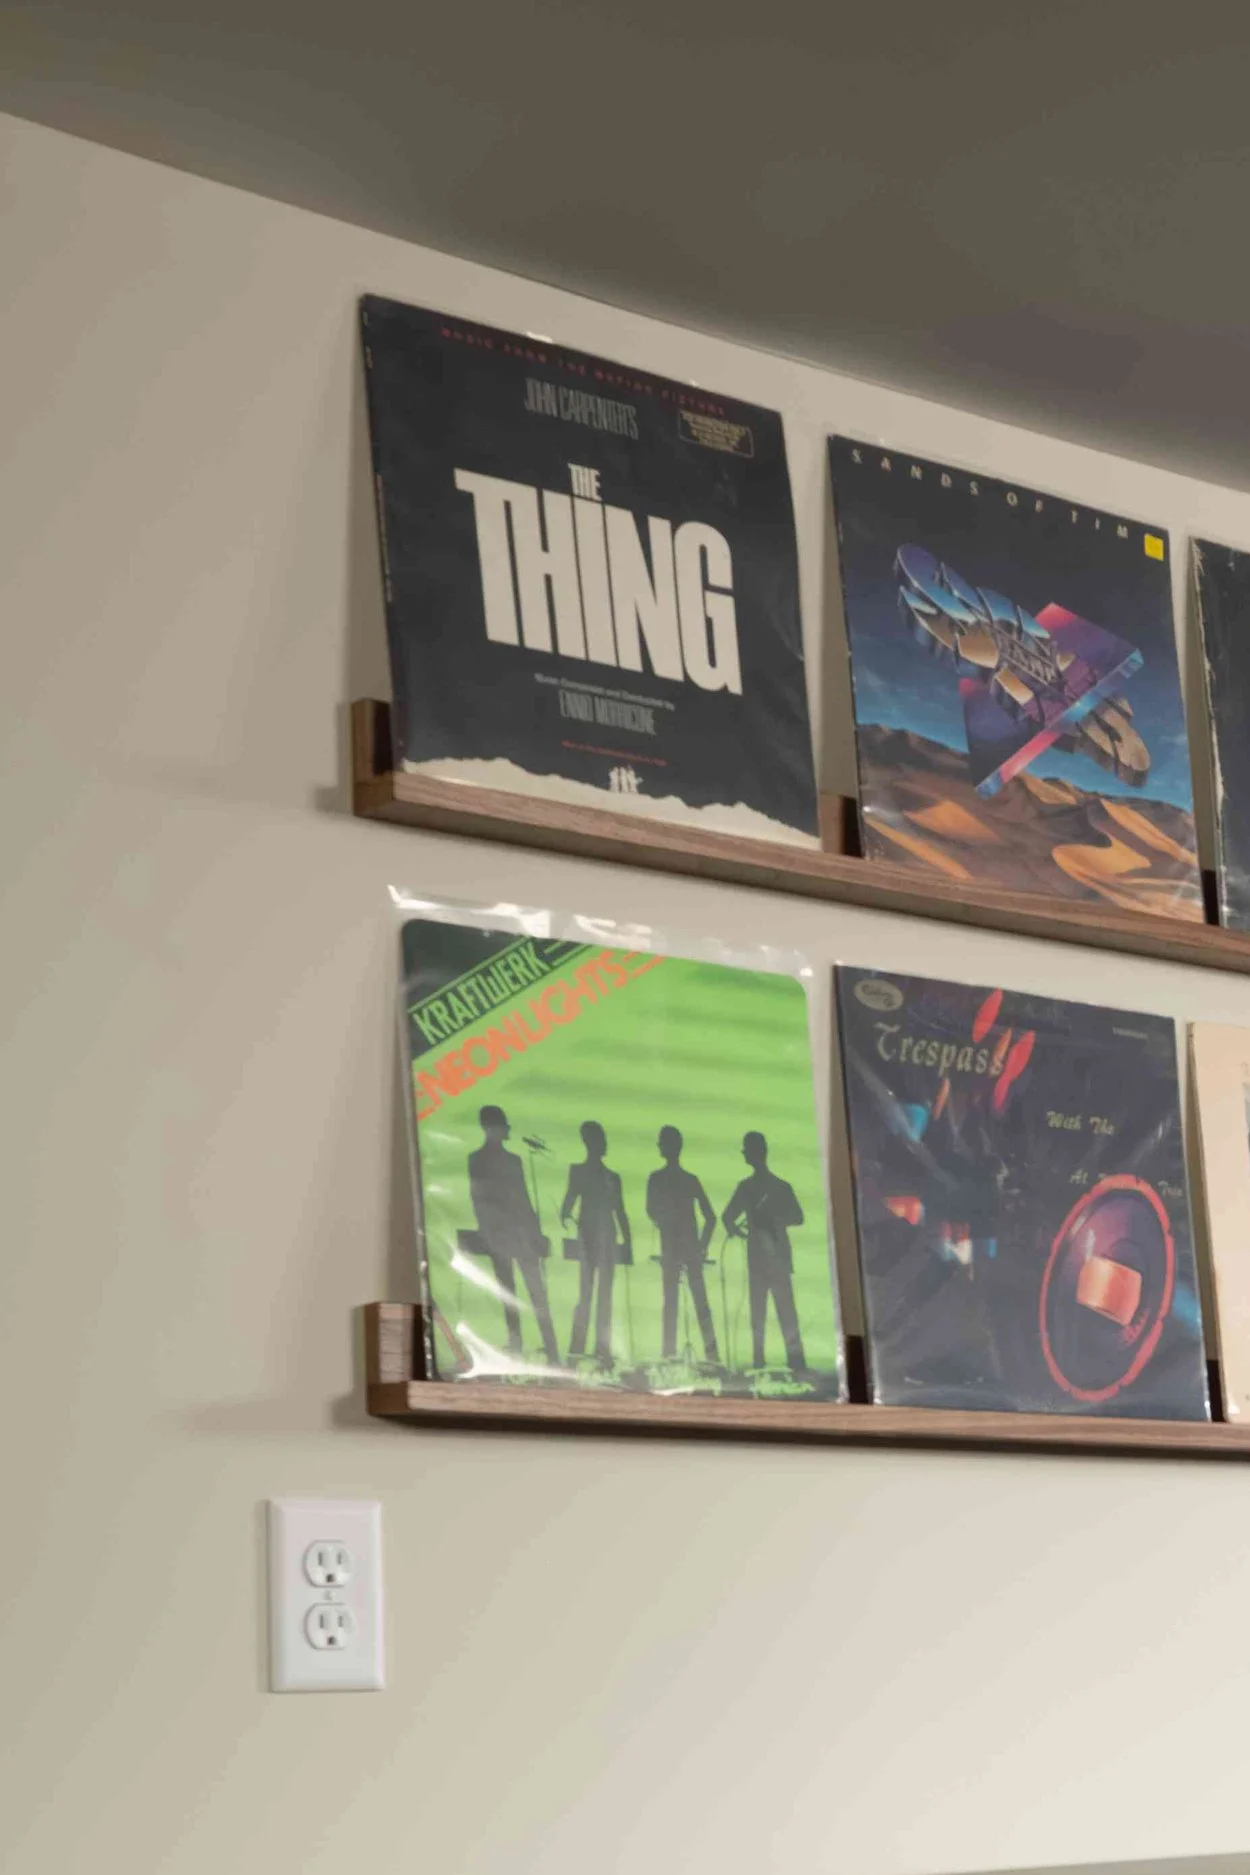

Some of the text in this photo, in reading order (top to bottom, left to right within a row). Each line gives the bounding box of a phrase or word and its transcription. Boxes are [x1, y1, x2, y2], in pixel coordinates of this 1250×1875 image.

[567, 462, 603, 501] THE
[852, 447, 980, 497] SANDS
[1070, 508, 1129, 540] TIM
[453, 467, 743, 696] THING
[413, 941, 551, 1046] KRAFTWERK
[873, 1022, 1003, 1078] Trespass
